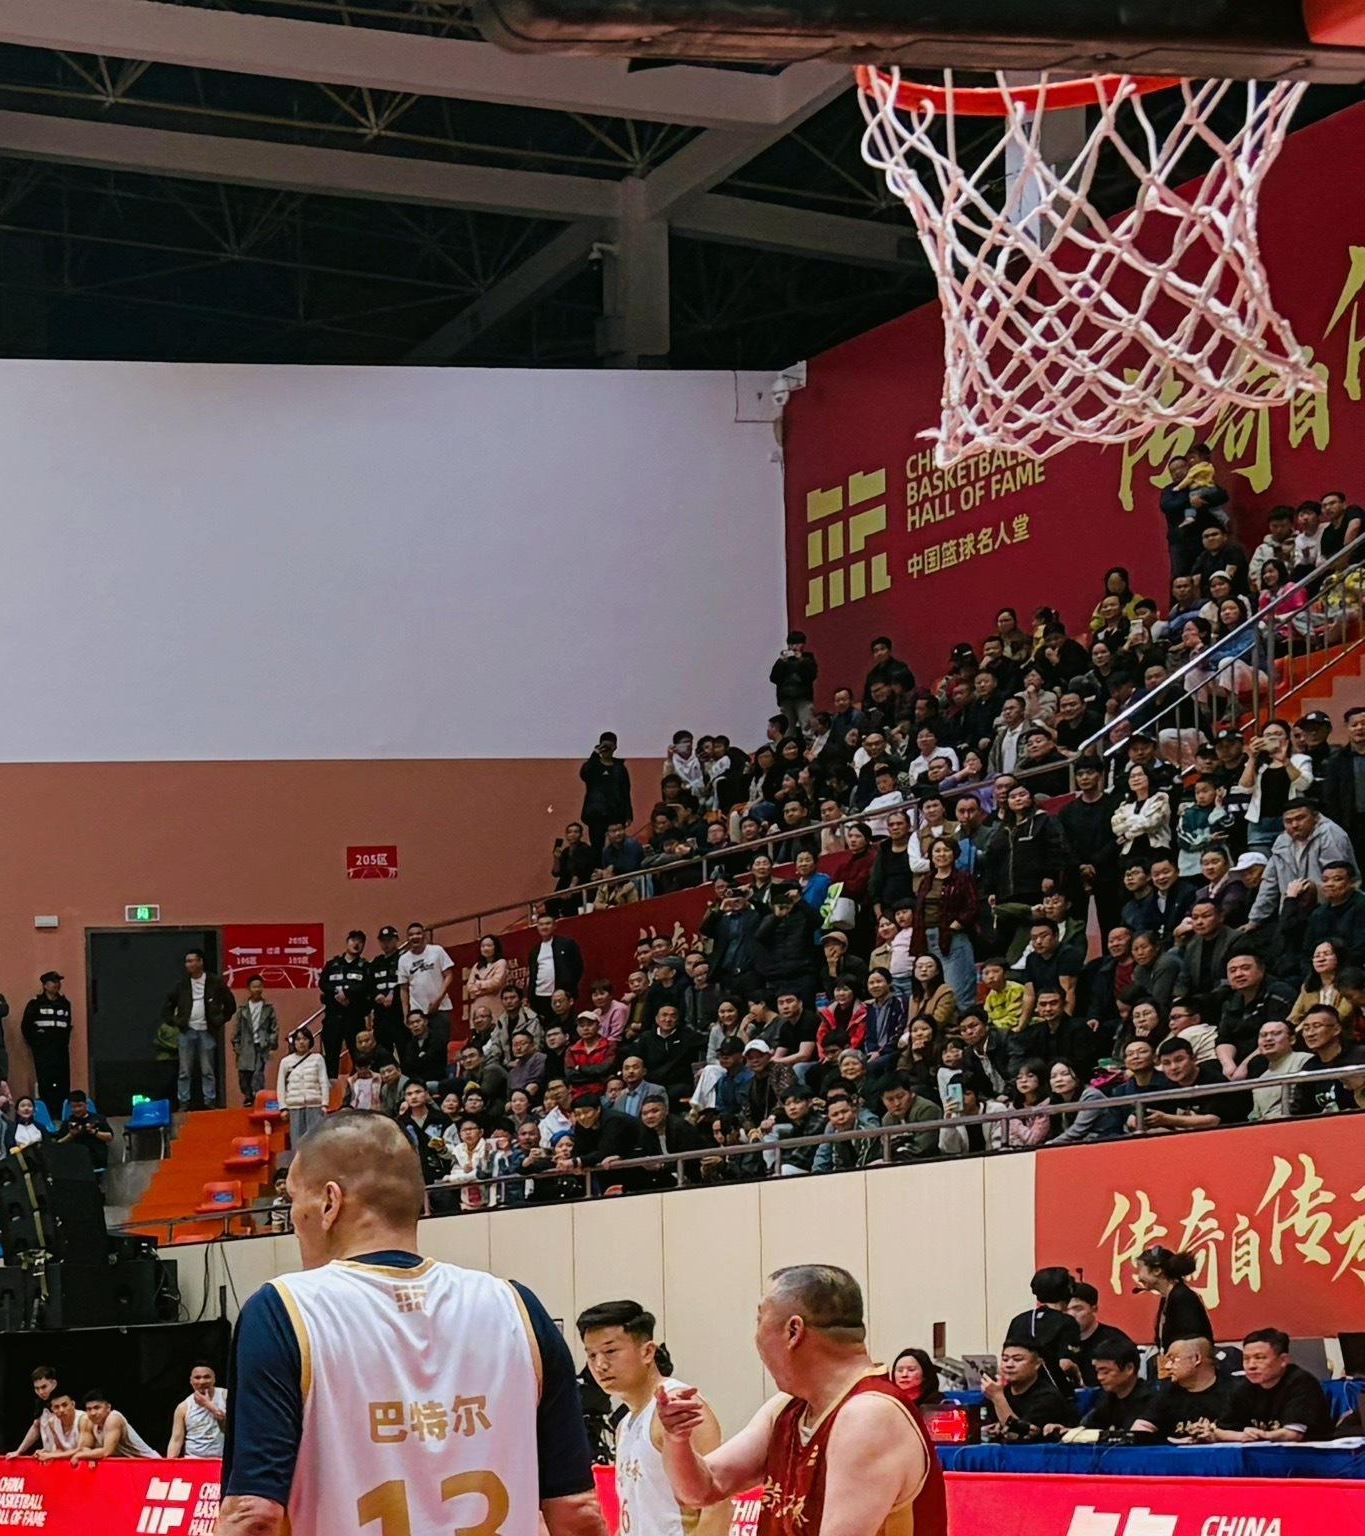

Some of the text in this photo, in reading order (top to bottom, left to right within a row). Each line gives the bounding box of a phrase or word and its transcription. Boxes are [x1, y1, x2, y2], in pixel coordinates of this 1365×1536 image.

[907, 460, 1046, 532] HALL OF FAME
[907, 513, 1030, 579] 中国篮球名人堂
[355, 854, 388, 866] 205区
[368, 1395, 492, 1443] 巴特尔
[10, 1511, 22, 1525] OF
[22, 1511, 47, 1527] FAME
